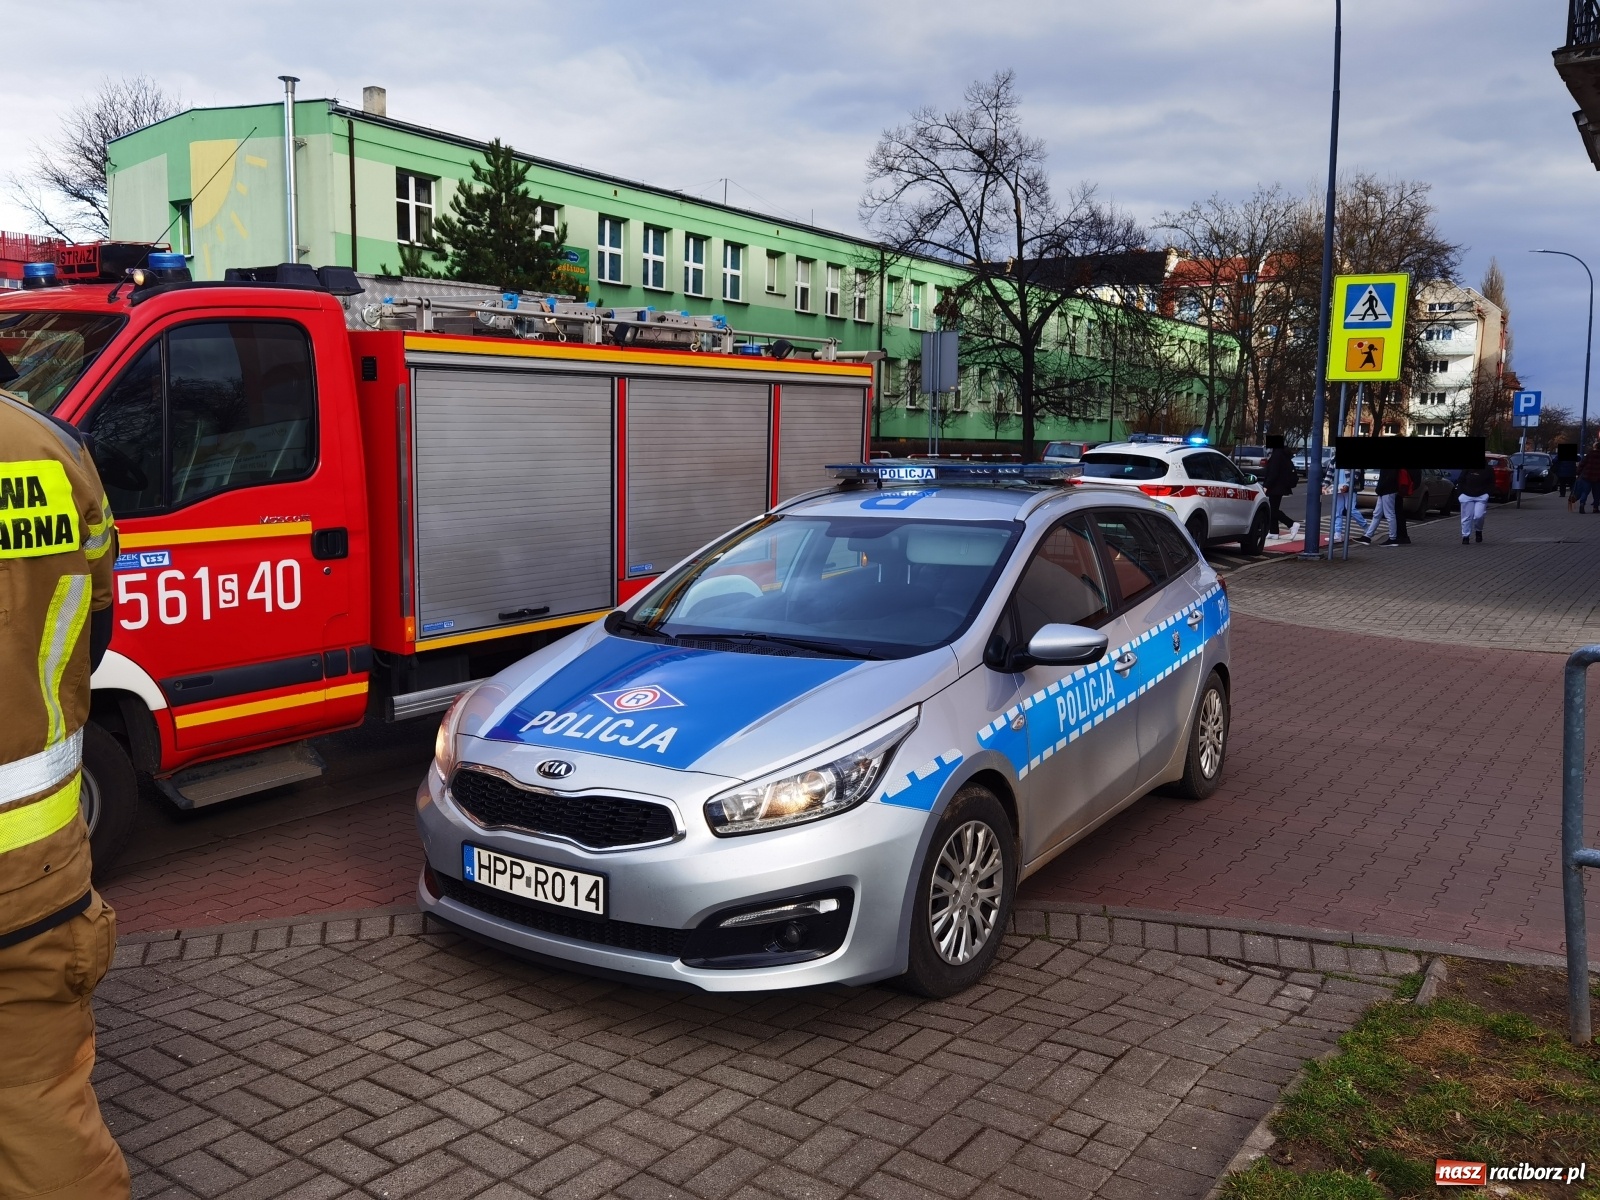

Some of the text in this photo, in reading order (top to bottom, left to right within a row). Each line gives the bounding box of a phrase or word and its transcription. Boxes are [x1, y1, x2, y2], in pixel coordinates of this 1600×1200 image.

[1519, 393, 1536, 413] P
[880, 468, 934, 479] POLICJA
[625, 693, 649, 705] R
[1056, 668, 1116, 733] POLICJA
[518, 710, 678, 754] POLICJA
[465, 866, 474, 876] PL
[477, 850, 526, 891] HPP
